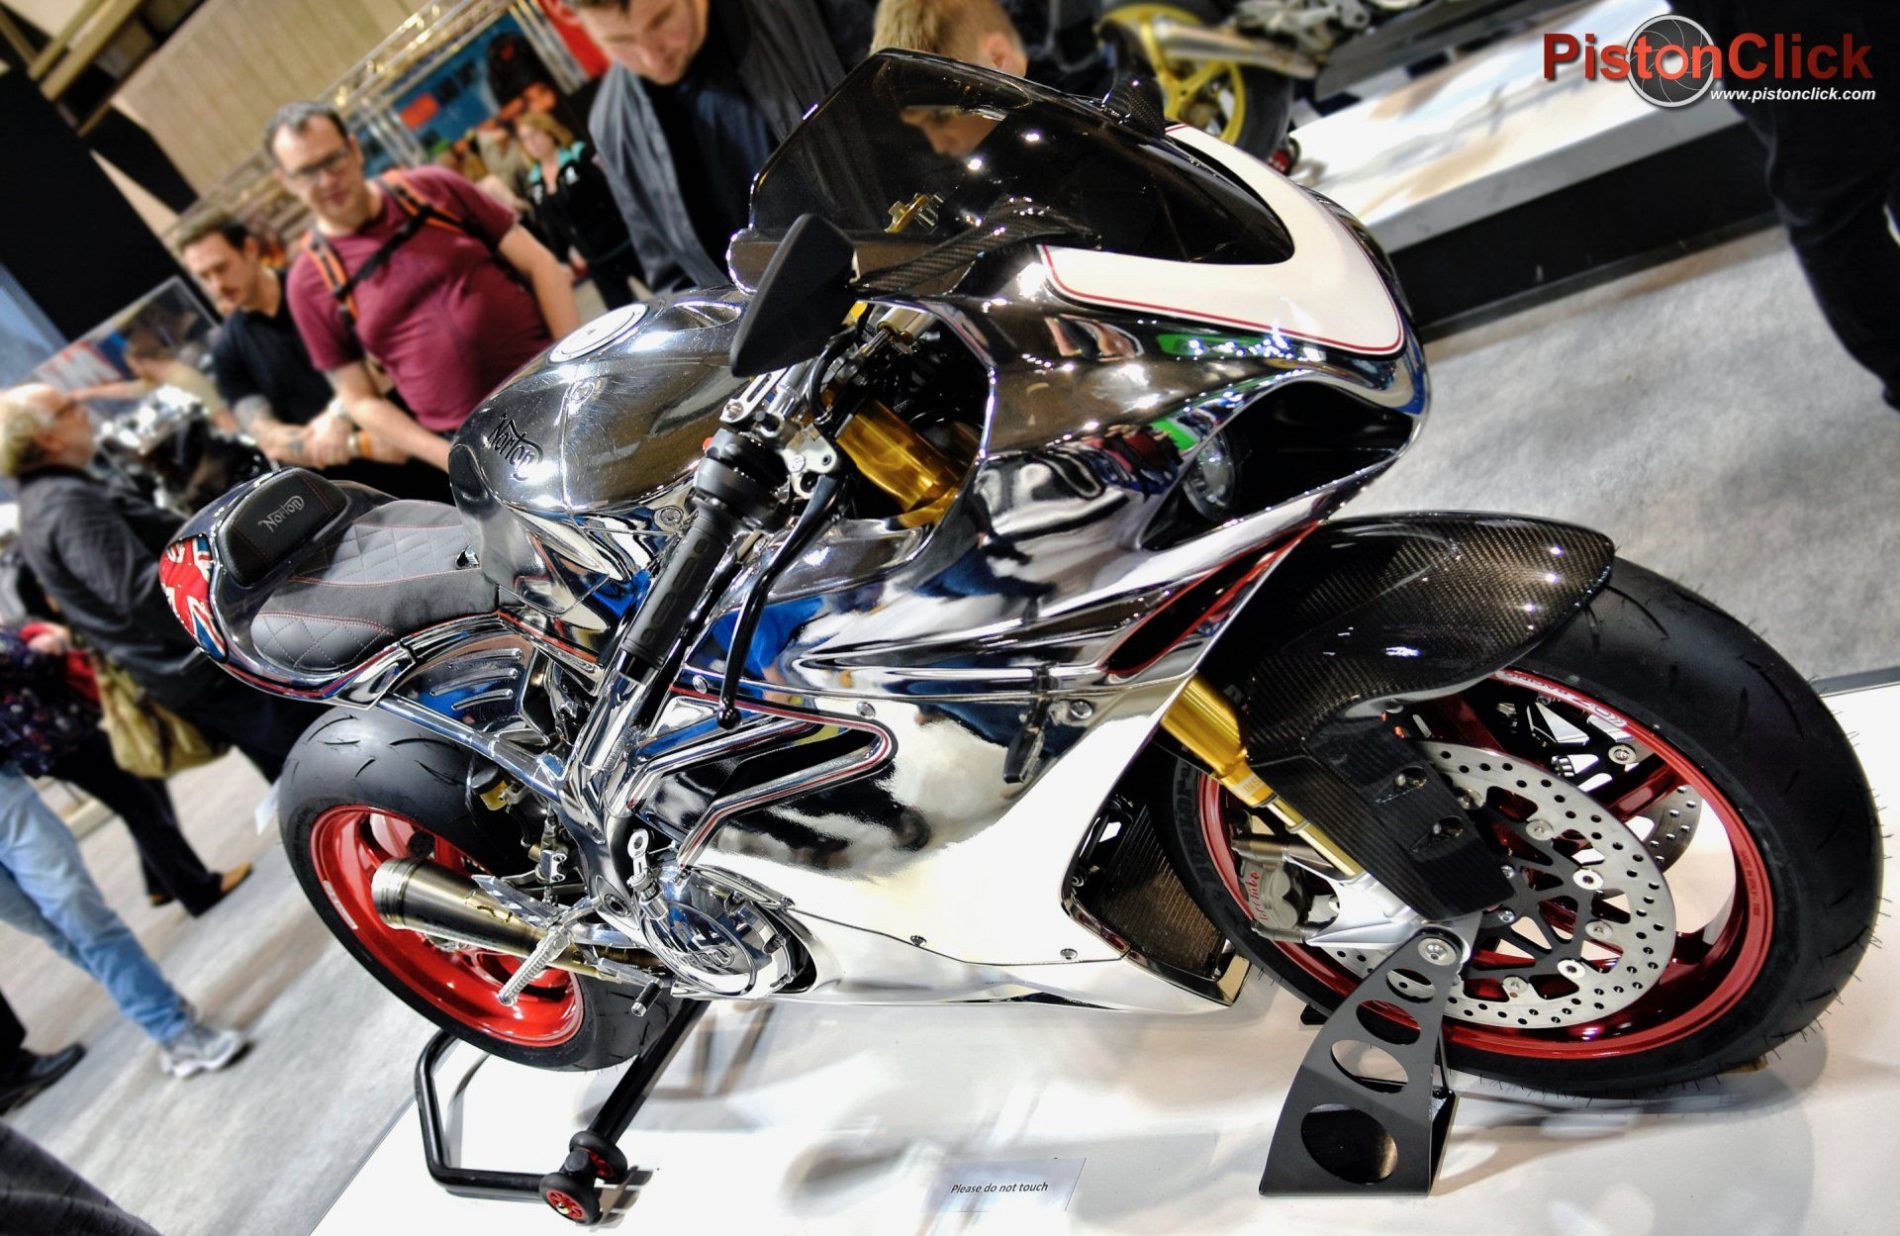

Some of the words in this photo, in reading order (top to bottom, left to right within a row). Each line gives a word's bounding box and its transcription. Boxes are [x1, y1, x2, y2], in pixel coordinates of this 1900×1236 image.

[487, 413, 543, 481] Norton
[257, 495, 305, 532] Norton
[950, 1183, 982, 1194] Please
[984, 1182, 997, 1192] do
[999, 1183, 1017, 1192] not
[1018, 1181, 1049, 1192] touch
